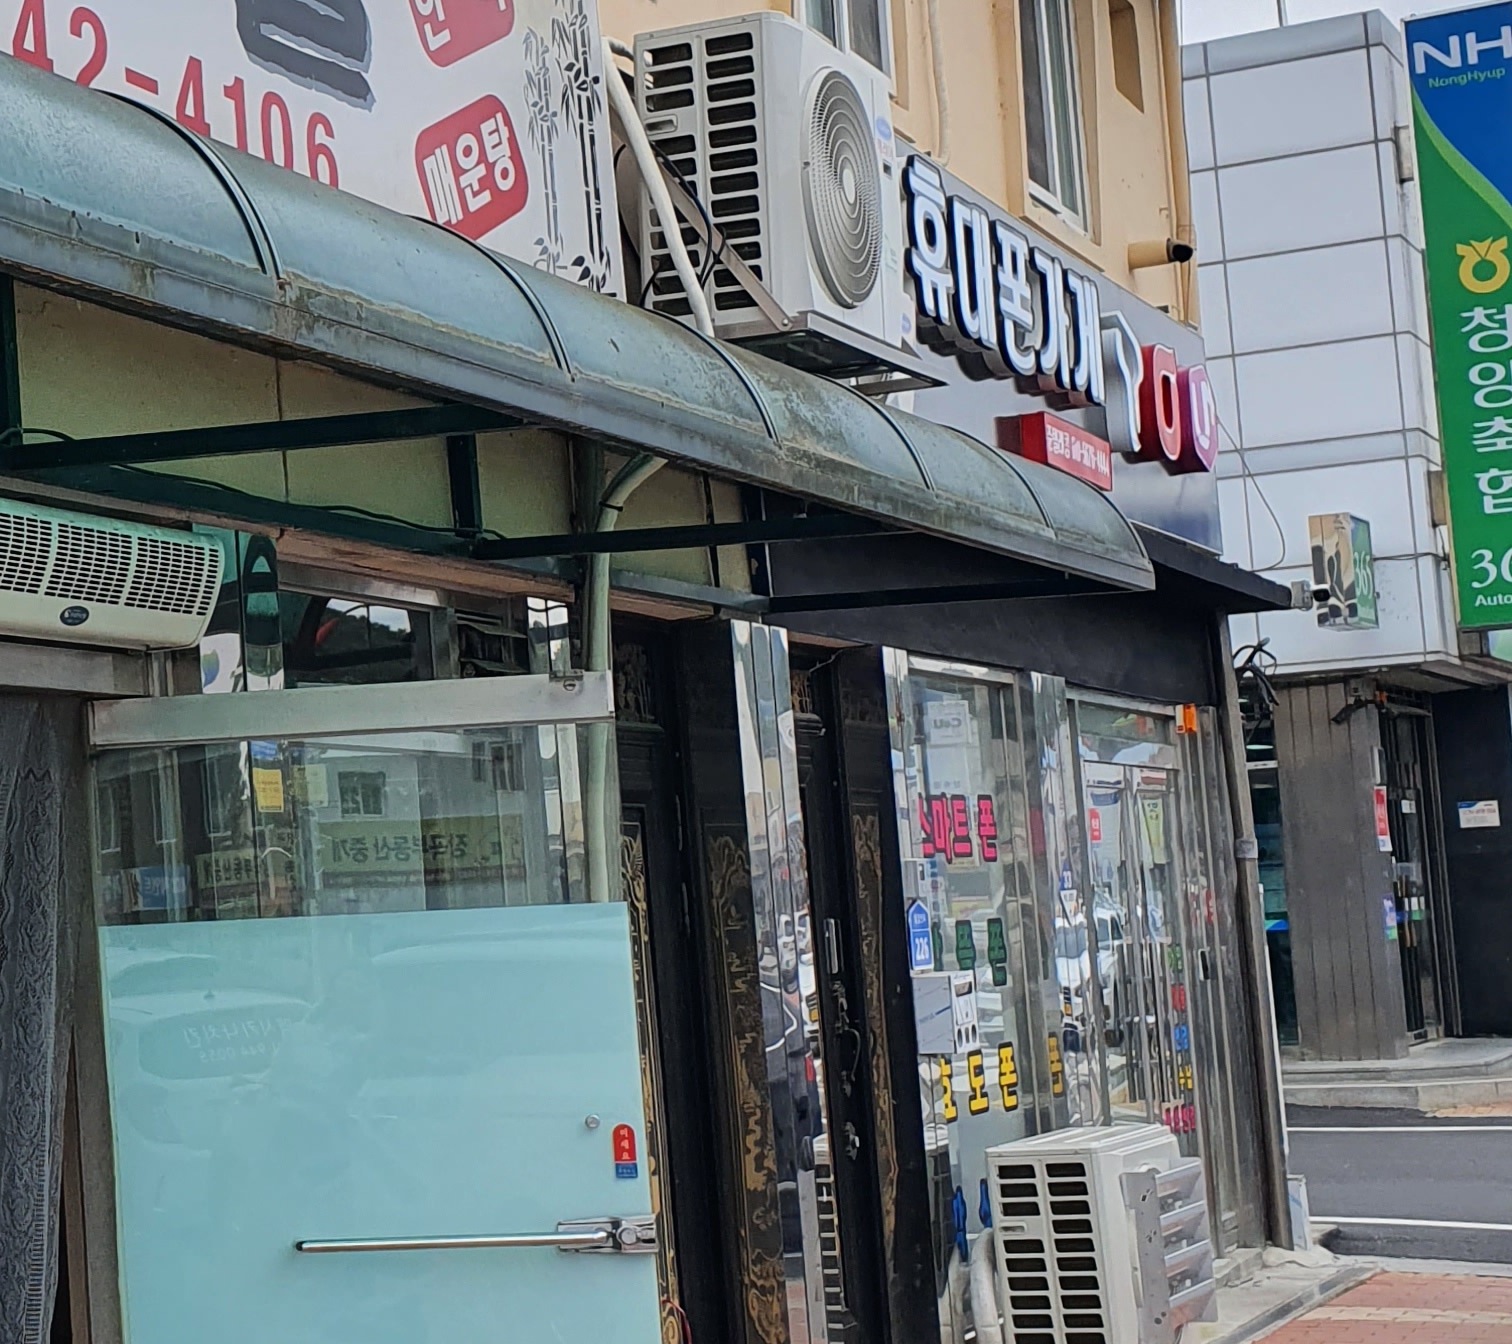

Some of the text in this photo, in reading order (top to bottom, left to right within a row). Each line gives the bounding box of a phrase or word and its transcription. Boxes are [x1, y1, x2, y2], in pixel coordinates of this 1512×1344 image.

[1412, 25, 1512, 74] NH
[1428, 67, 1506, 88] NongHyup
[423, 112, 516, 226] 매운탕
[904, 154, 1106, 407] 휴대폰가게
[1353, 551, 1373, 599] 365
